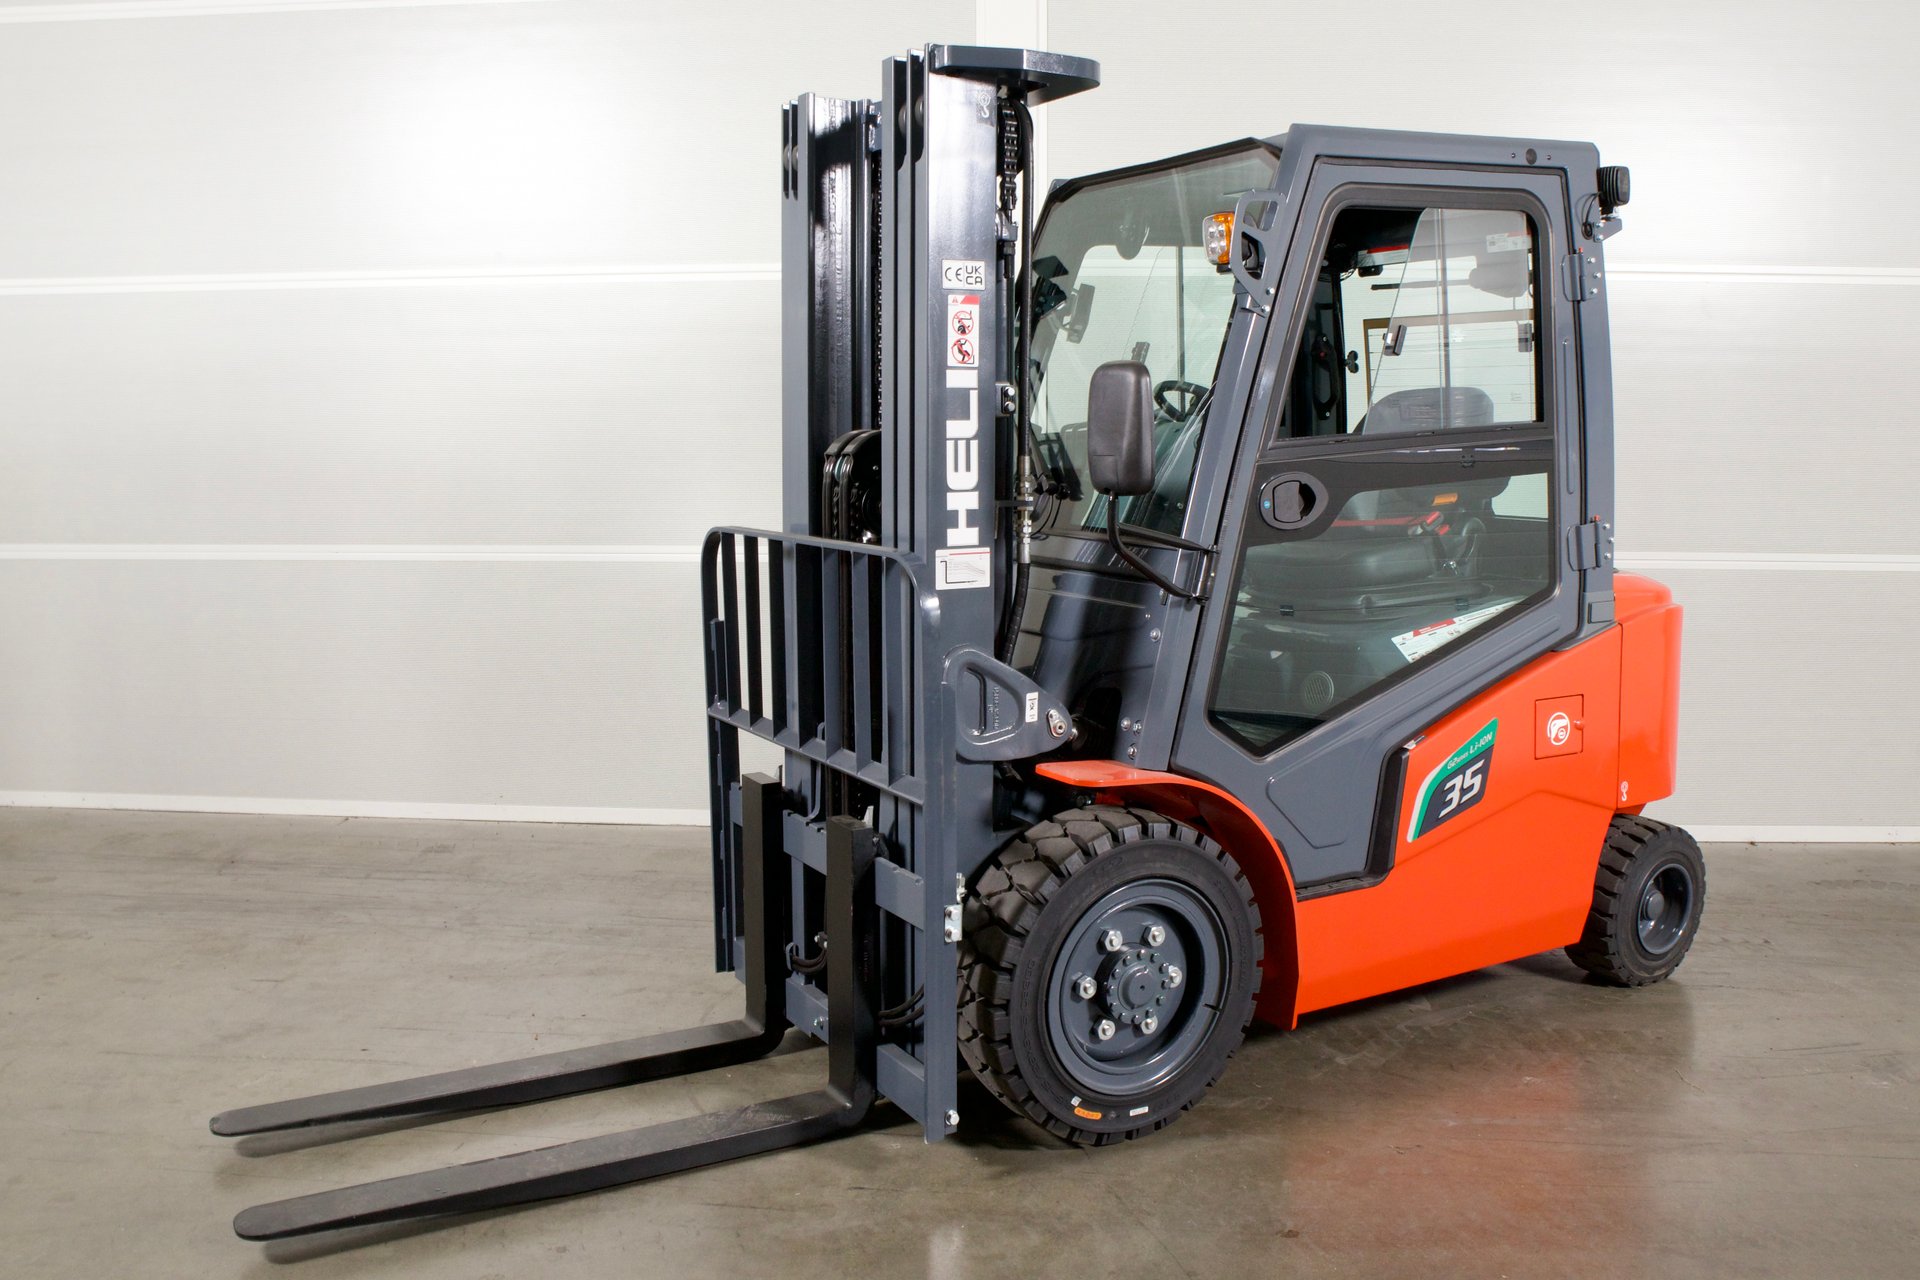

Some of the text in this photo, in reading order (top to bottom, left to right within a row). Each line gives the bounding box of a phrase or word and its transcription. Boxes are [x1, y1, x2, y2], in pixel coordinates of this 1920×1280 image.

[945, 267, 963, 282] CE
[966, 265, 982, 275] UK
[966, 276, 983, 286] CA
[946, 369, 979, 547] HELI
[1438, 759, 1485, 819] 35
